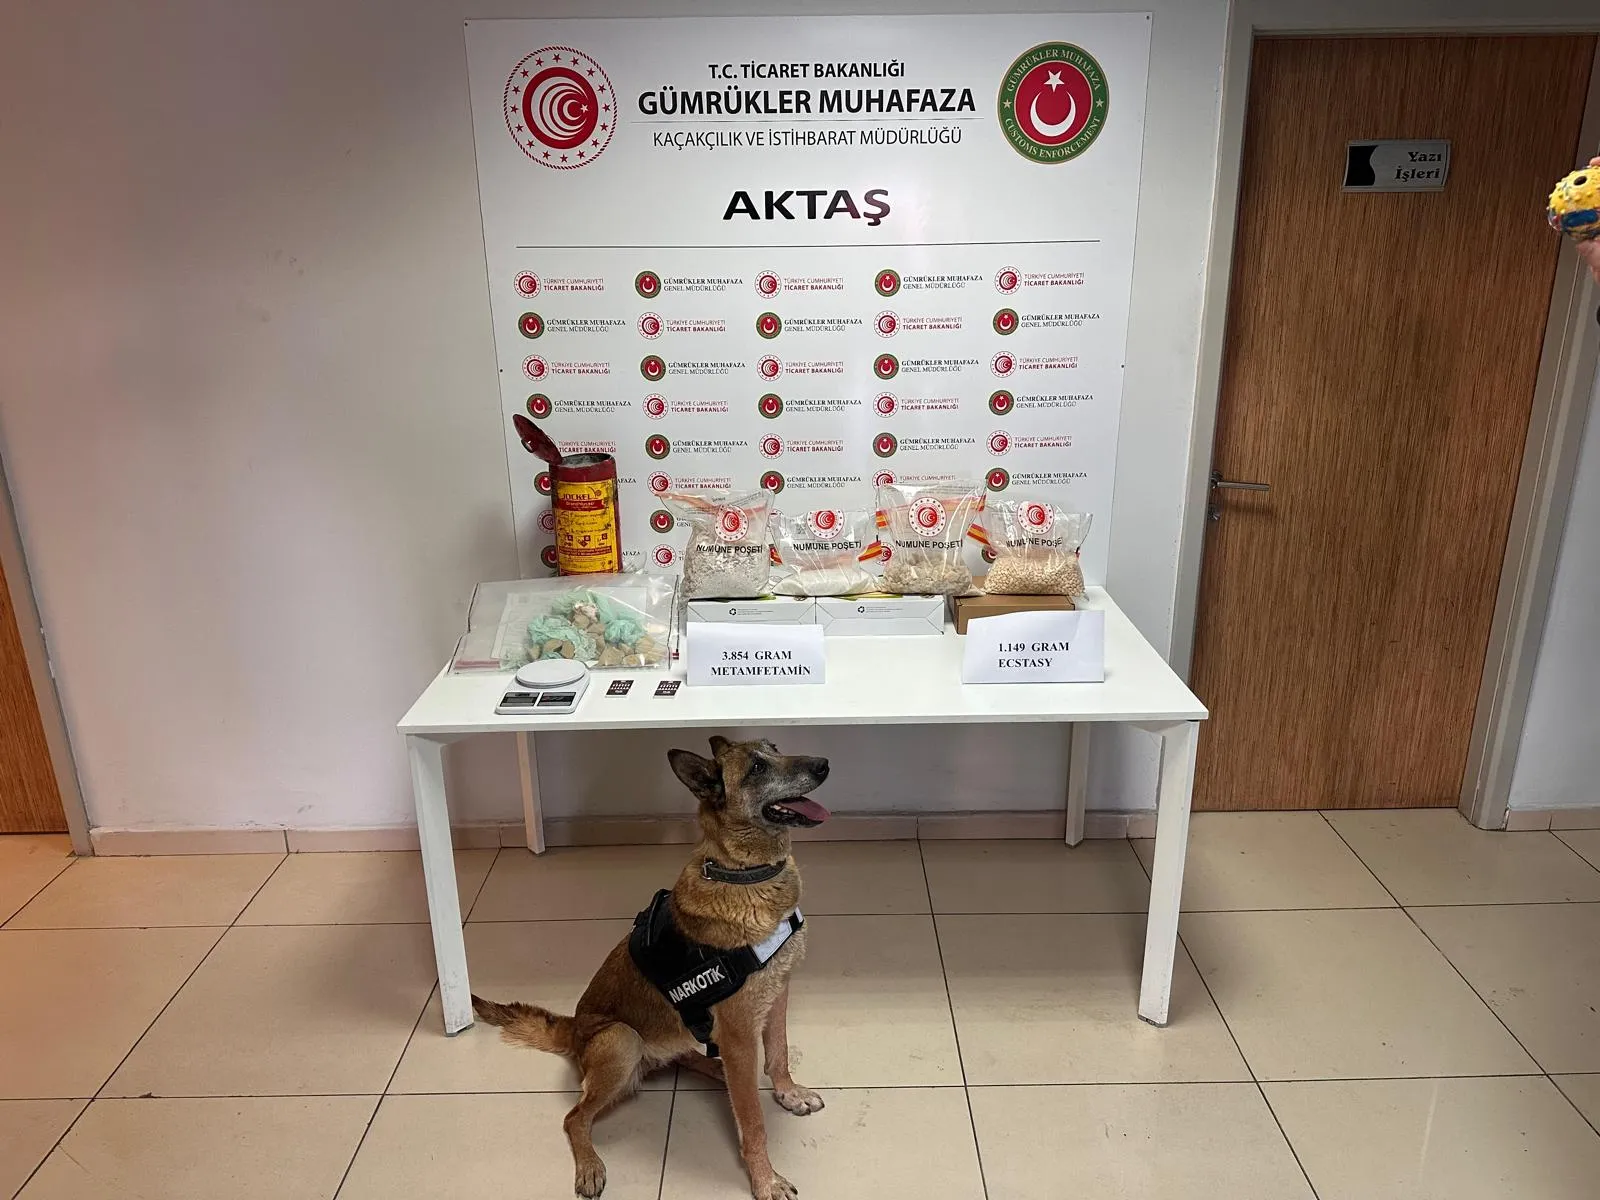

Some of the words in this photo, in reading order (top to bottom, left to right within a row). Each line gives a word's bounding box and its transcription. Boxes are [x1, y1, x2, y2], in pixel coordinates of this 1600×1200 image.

[709, 64, 737, 79] T.C.
[741, 61, 809, 79] TİCARET
[814, 59, 904, 78] BAKANLIĞI
[1006, 49, 1059, 92] GÜMRÜKLER
[1060, 49, 1101, 91] MUHAFAZA
[638, 85, 811, 115] GÜMRÜKLER
[819, 88, 976, 113] MUHAFAZA
[653, 132, 742, 150] KAÇAKÇILIK
[746, 132, 764, 146] VE
[769, 128, 856, 146] İSTİHBARAT
[860, 126, 962, 145] MÜDÜRLÜĞÜ
[1005, 118, 1038, 156] CUSTOMS
[1039, 116, 1101, 159] ENFORCEMENT
[1408, 151, 1442, 162] Yazı
[1395, 166, 1440, 182] İşleri
[723, 189, 890, 226] AKTAŞ
[696, 544, 734, 554] NUMUNE
[735, 545, 762, 555] POŞETİ
[793, 542, 829, 550] NUMUNE
[832, 540, 861, 551] POŞETİ
[896, 540, 930, 549] NUMUNE
[932, 538, 963, 550] POŞETİ
[999, 643, 1026, 652] 1.149
[1031, 642, 1069, 652] GRAM
[722, 651, 749, 660] 3.854
[754, 650, 792, 660] GRAM
[711, 664, 811, 676] METAMFETAMİN
[998, 658, 1053, 668] ECSTASY
[668, 965, 725, 1003] NARKOTİK
